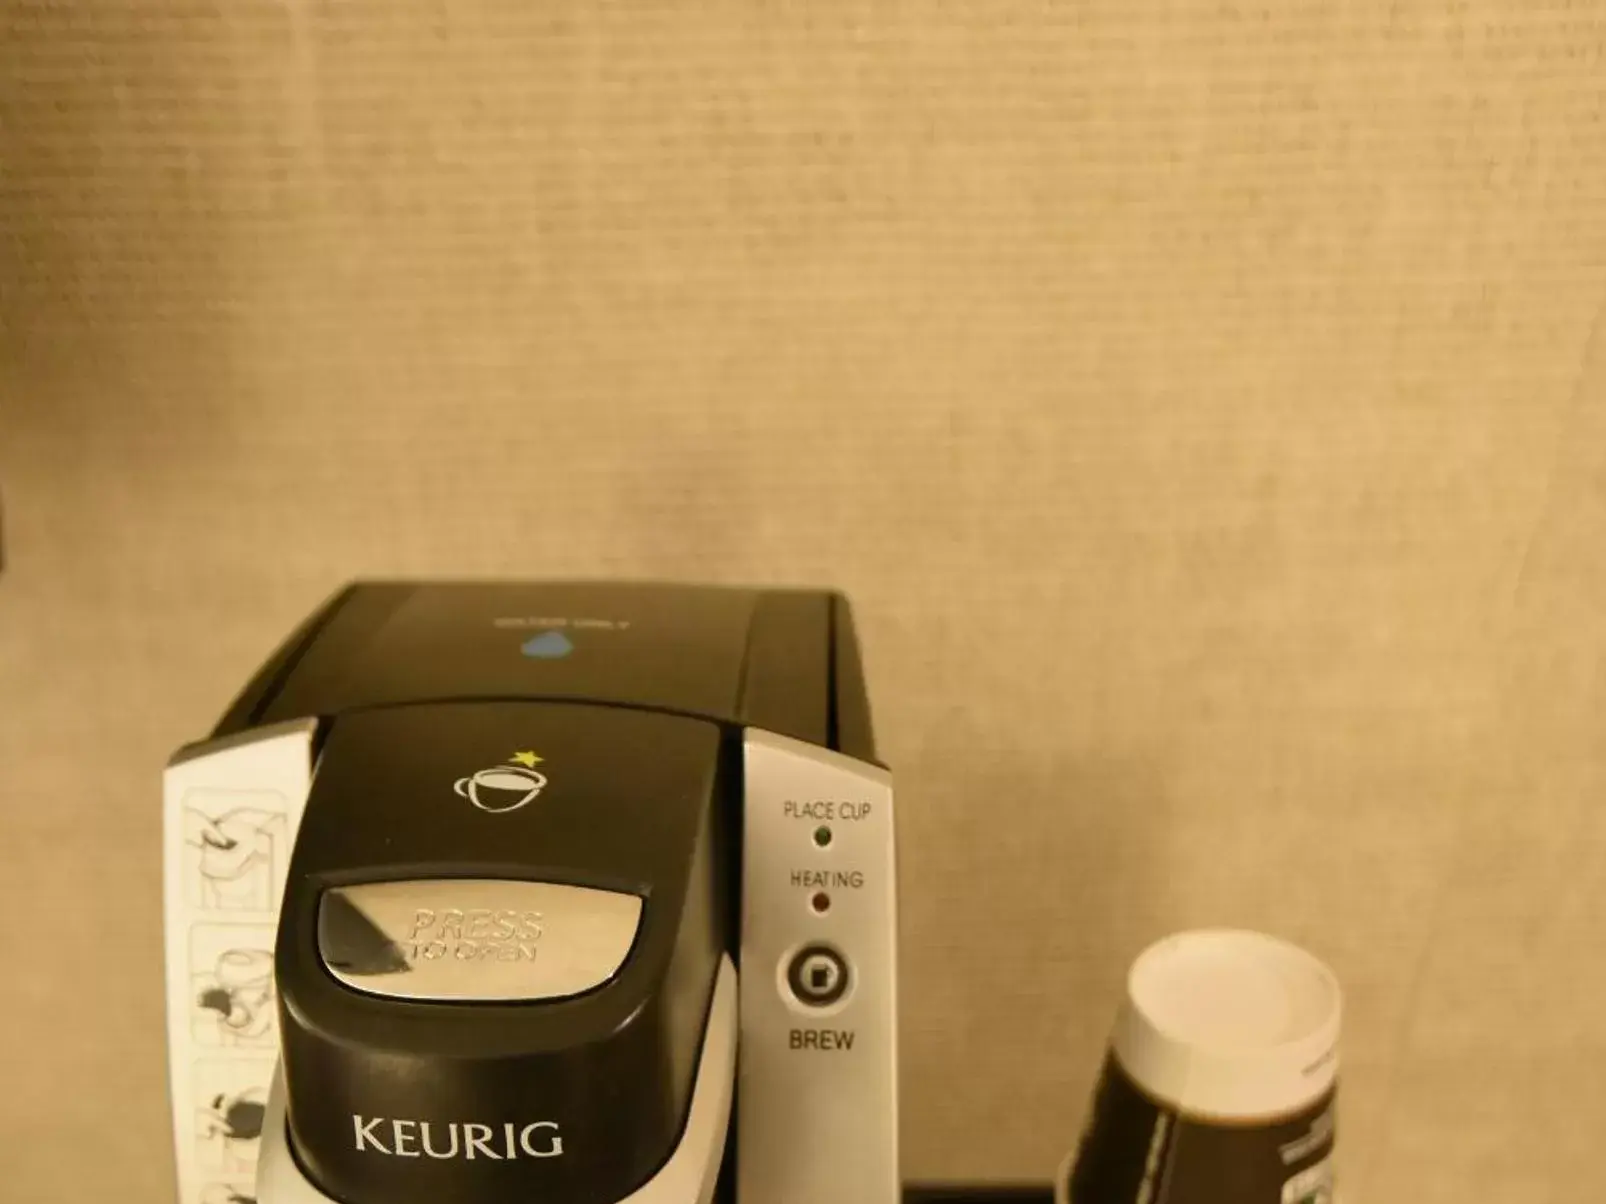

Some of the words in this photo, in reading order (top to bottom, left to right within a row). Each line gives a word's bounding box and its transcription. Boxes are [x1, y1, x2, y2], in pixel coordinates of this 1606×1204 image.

[784, 800, 834, 820] PLACE
[839, 801, 872, 820] CUP
[790, 868, 864, 888] HEATING
[410, 908, 543, 941] PRESS
[454, 940, 538, 963] OPEN
[789, 1028, 855, 1051] BREW
[353, 1114, 564, 1160] KEURIG
